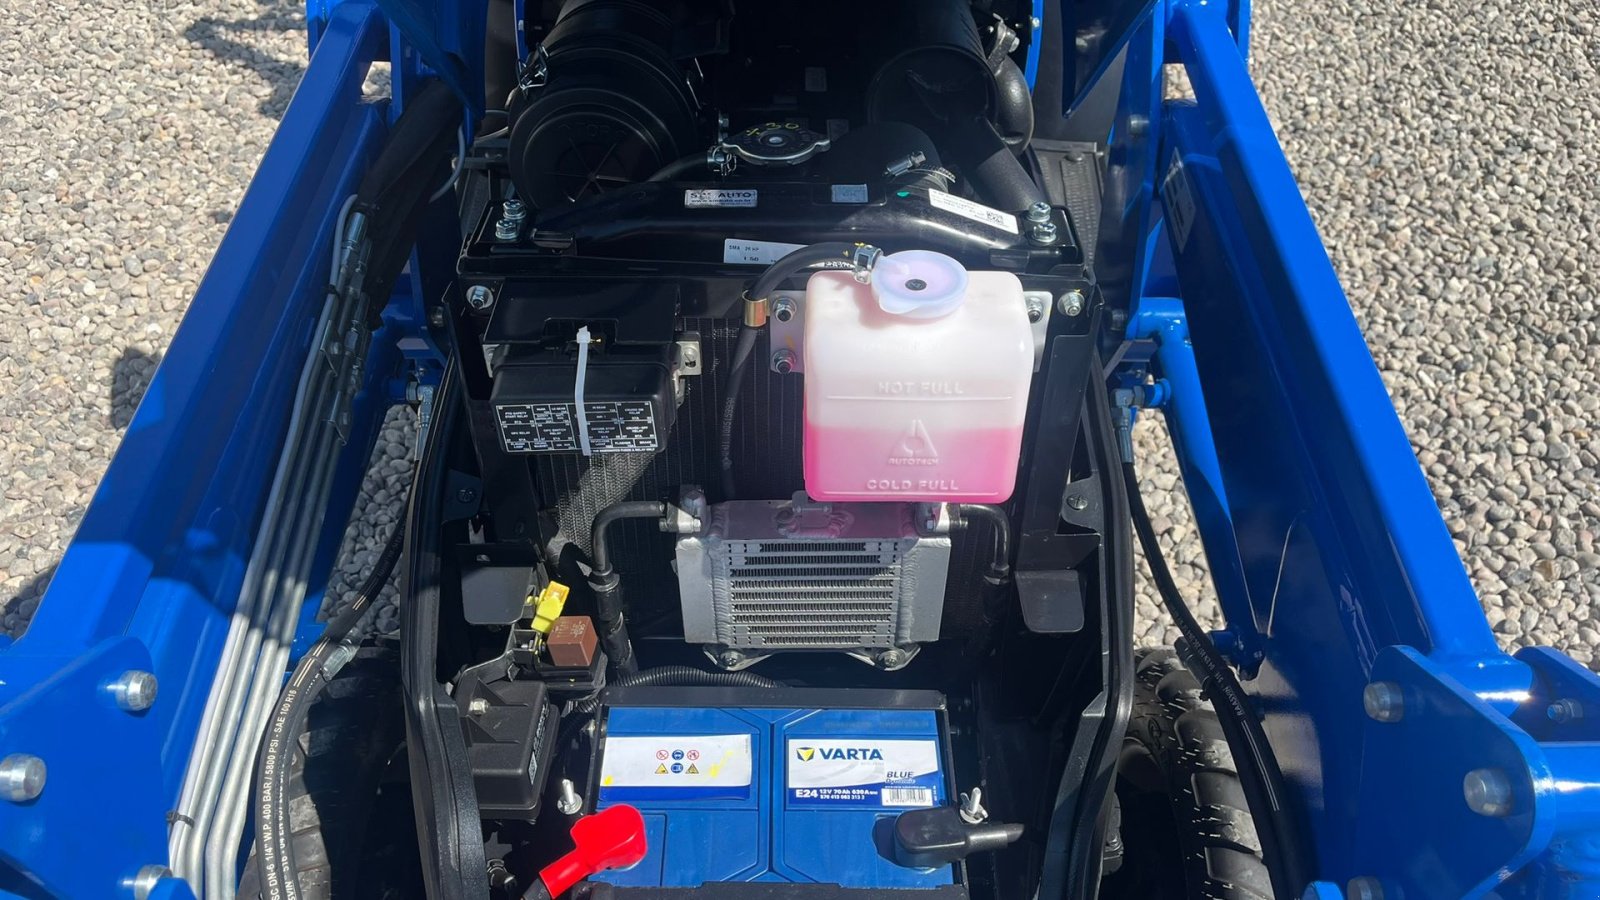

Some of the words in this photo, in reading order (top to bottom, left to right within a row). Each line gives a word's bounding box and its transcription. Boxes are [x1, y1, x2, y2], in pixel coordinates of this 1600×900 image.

[878, 381, 915, 394] HOT
[920, 381, 964, 394] FULL
[867, 479, 912, 490] COLD
[919, 479, 960, 490] FULL
[279, 703, 291, 715] 100
[273, 716, 286, 733] SAE
[268, 739, 280, 753] PSI
[819, 748, 883, 760] VARTA
[265, 754, 276, 774] 5800
[262, 781, 272, 802] BAR
[795, 789, 818, 798] E24
[262, 803, 272, 820] 400
[262, 822, 273, 842] W.P.
[266, 863, 278, 887] DN-6
